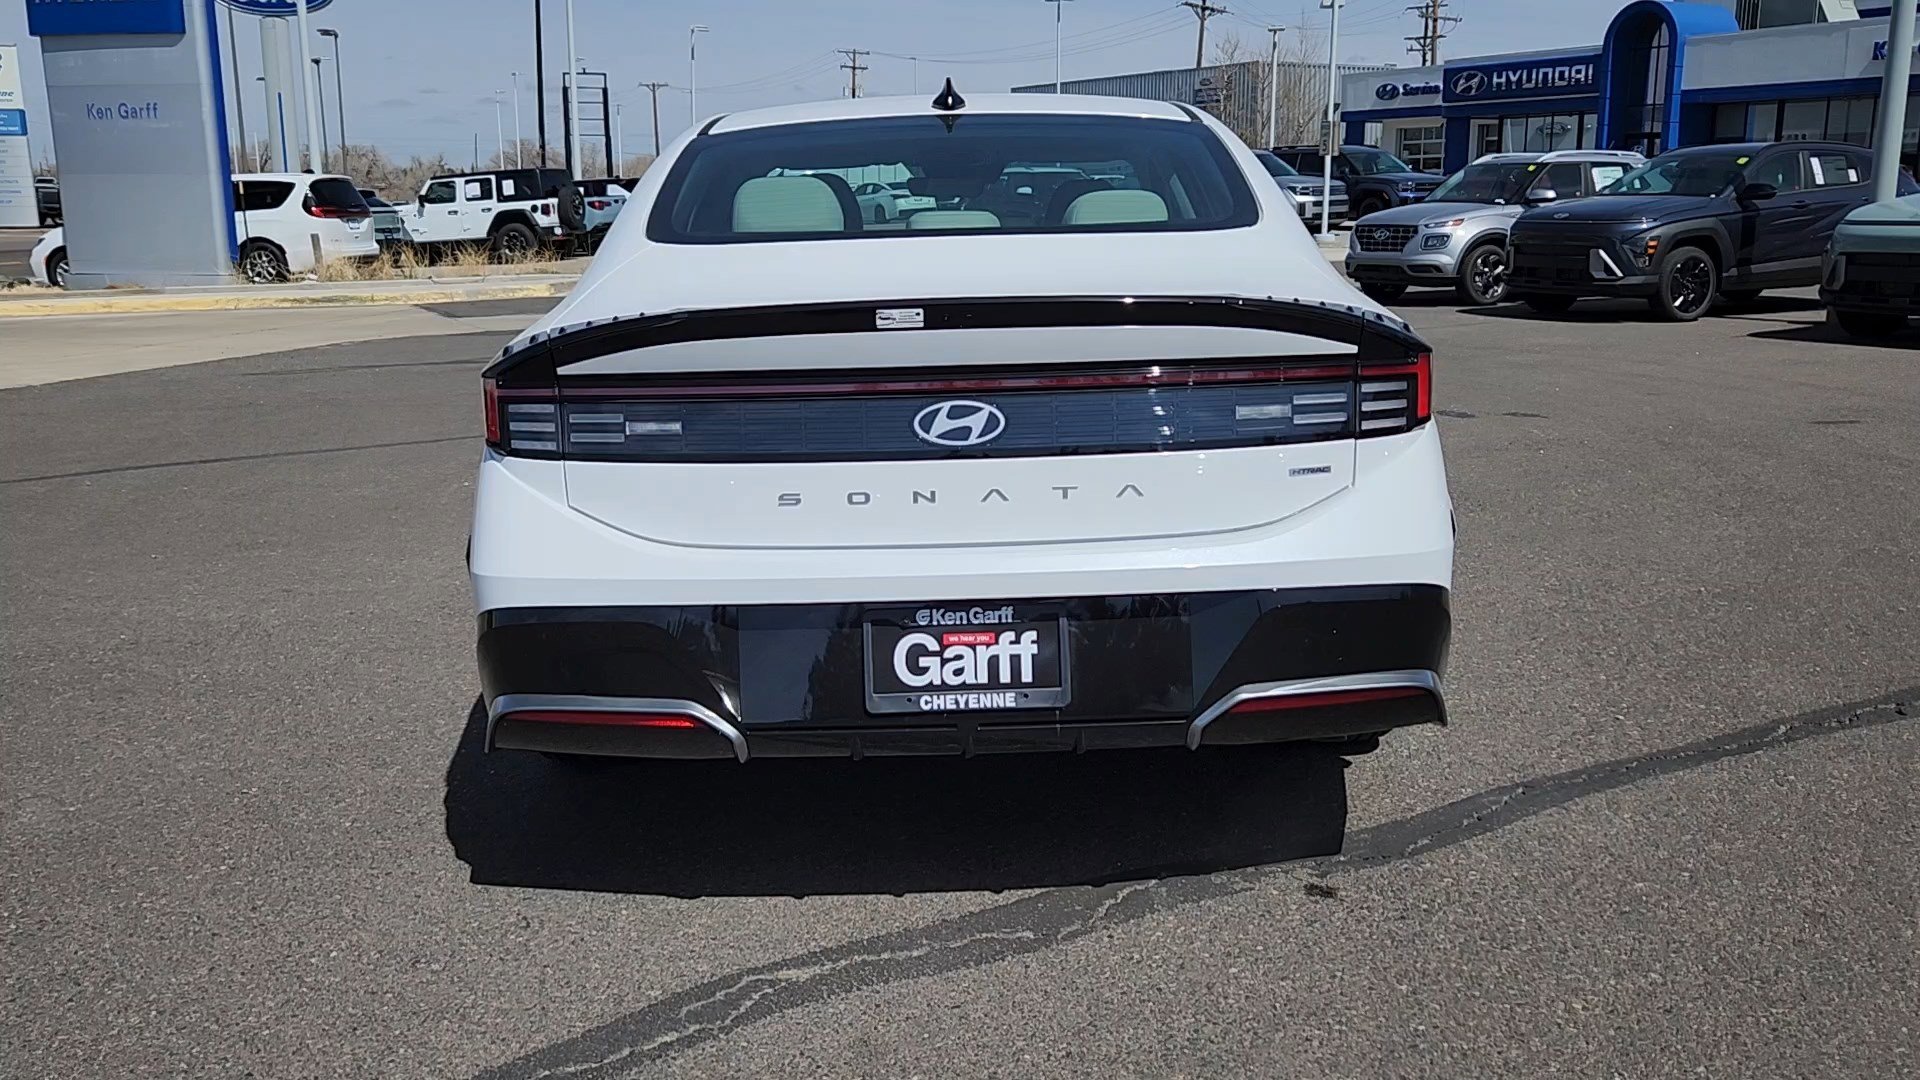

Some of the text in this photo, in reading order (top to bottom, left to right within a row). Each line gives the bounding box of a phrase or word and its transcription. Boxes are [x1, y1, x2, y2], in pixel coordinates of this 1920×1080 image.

[1491, 63, 1594, 91] HYUNDAI
[86, 102, 158, 120] Ken Garff
[1289, 466, 1331, 476] HTRAC
[777, 484, 1145, 507] SONATA
[932, 606, 1014, 625] Ken Garff
[976, 635, 990, 643] you
[893, 630, 1039, 687] Garff
[919, 692, 1016, 710] CHEYENNE
